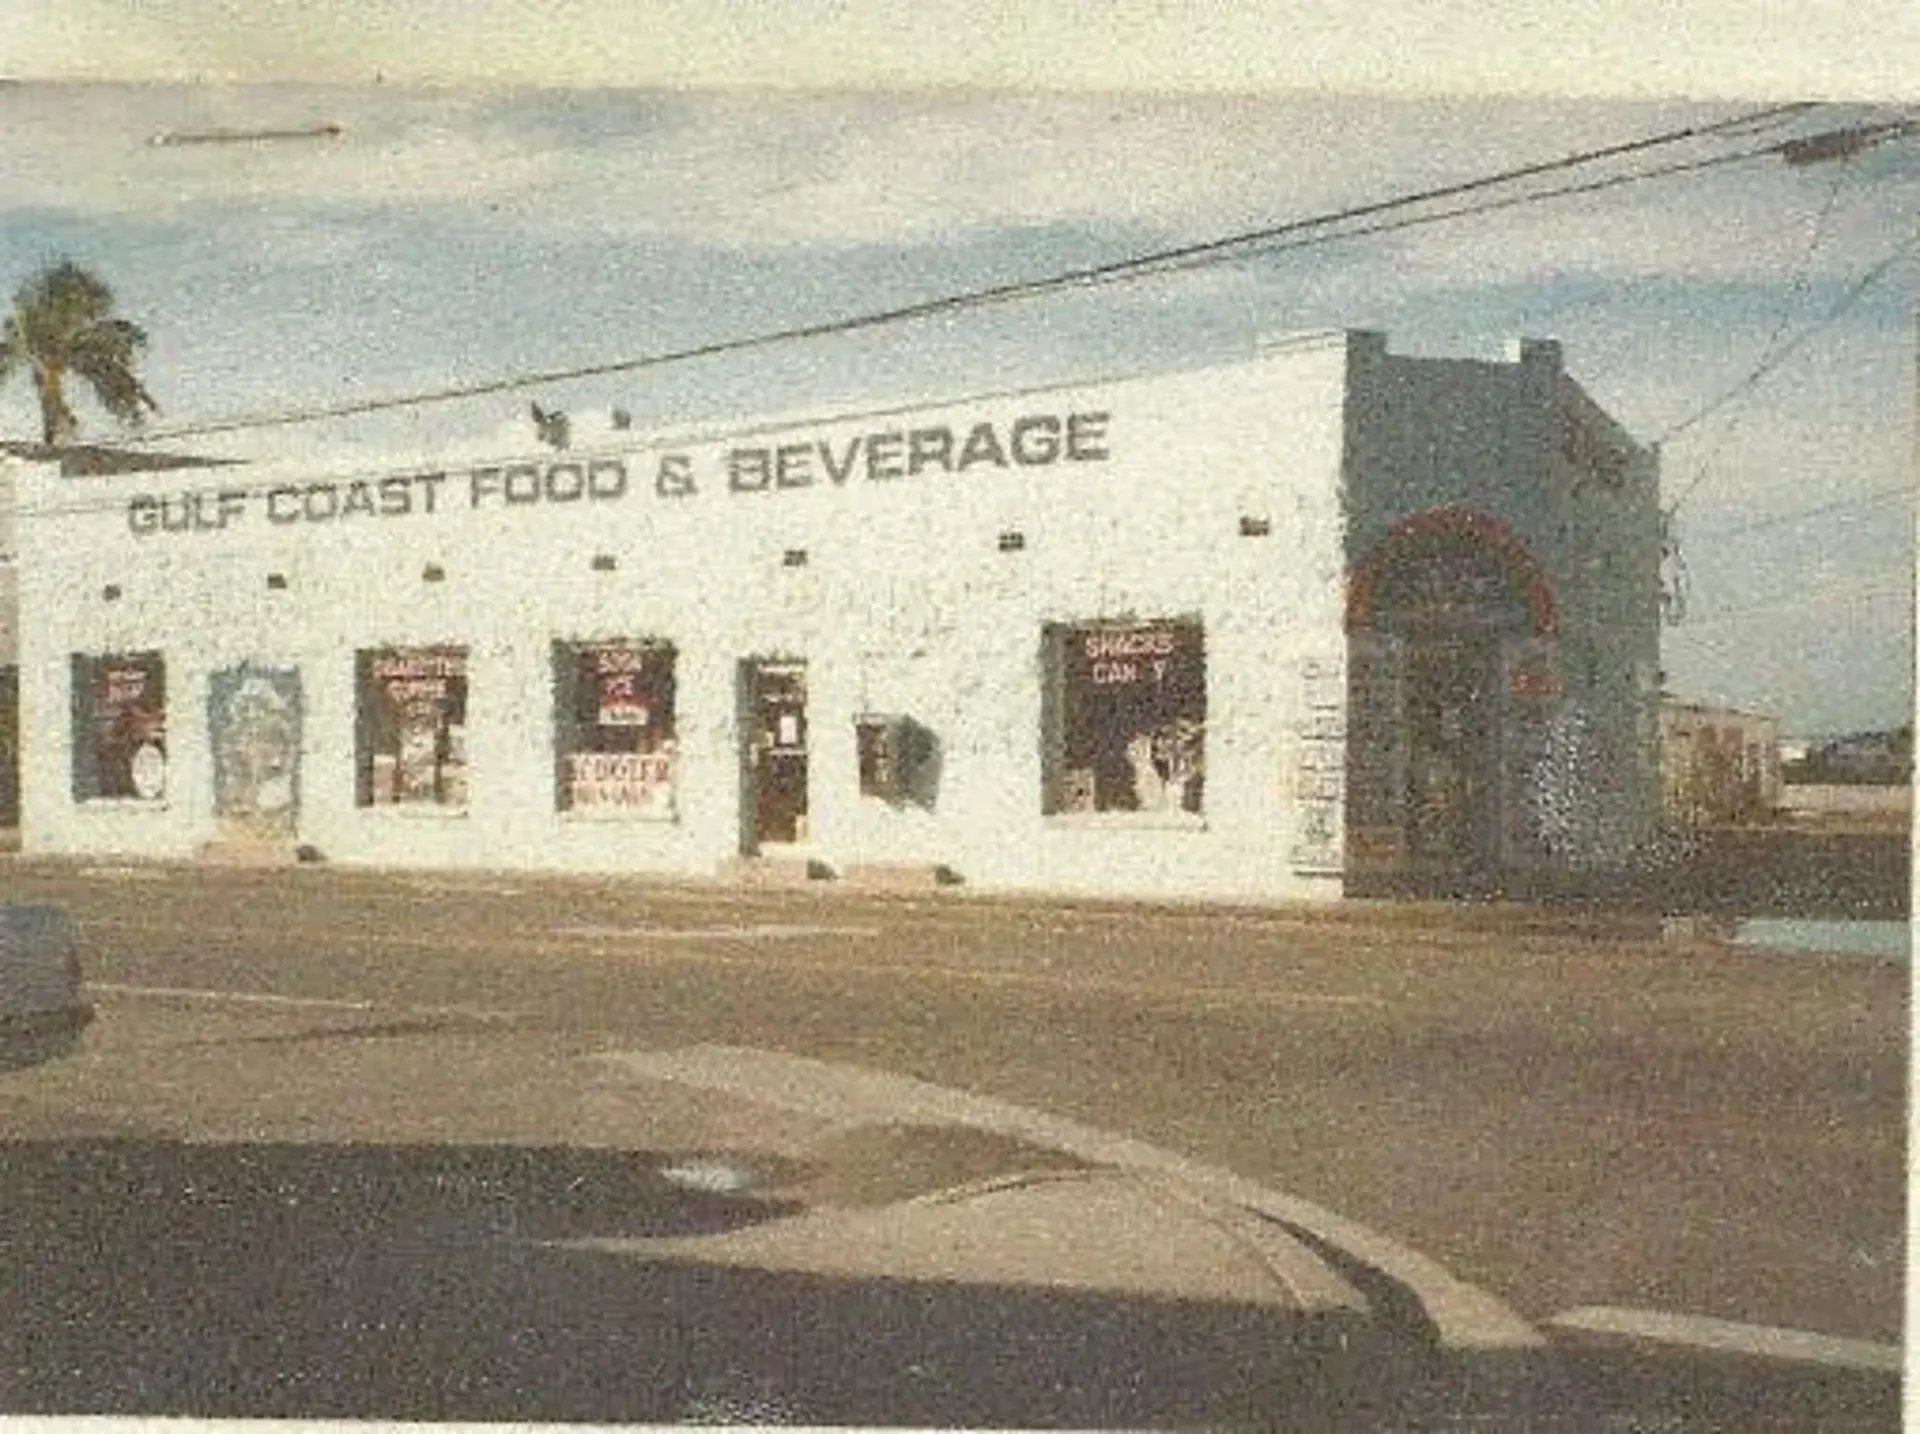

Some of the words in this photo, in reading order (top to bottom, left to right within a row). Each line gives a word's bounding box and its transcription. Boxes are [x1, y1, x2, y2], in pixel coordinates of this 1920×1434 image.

[127, 491, 247, 535] GULF
[266, 473, 446, 525] COAST
[470, 457, 627, 508] FOOD
[655, 455, 697, 497] &
[727, 412, 1110, 494] BEVERAGE
[1092, 660, 1167, 685] CANY
